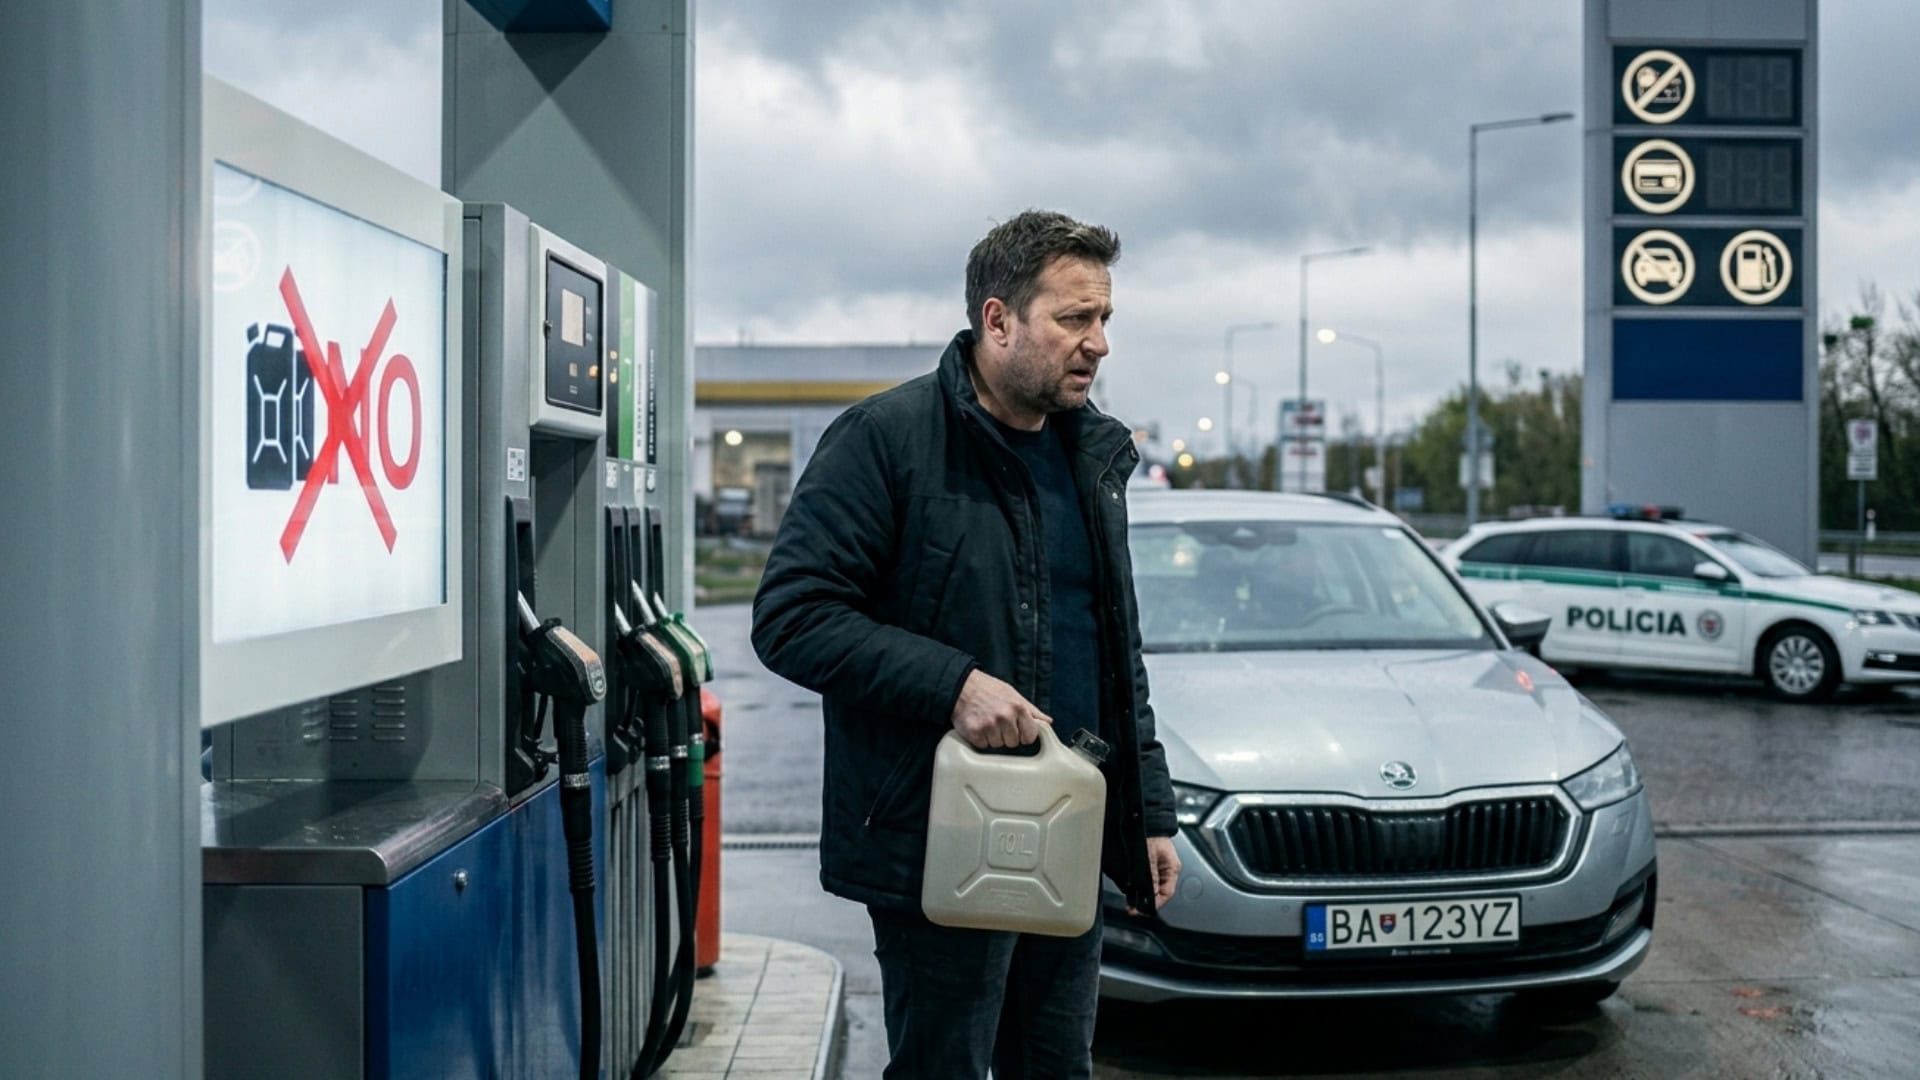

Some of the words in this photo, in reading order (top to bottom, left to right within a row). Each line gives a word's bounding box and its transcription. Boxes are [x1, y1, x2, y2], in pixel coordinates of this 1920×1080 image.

[327, 341, 422, 490] NO
[1332, 908, 1377, 944] BA
[1403, 902, 1513, 941] 123YZ
